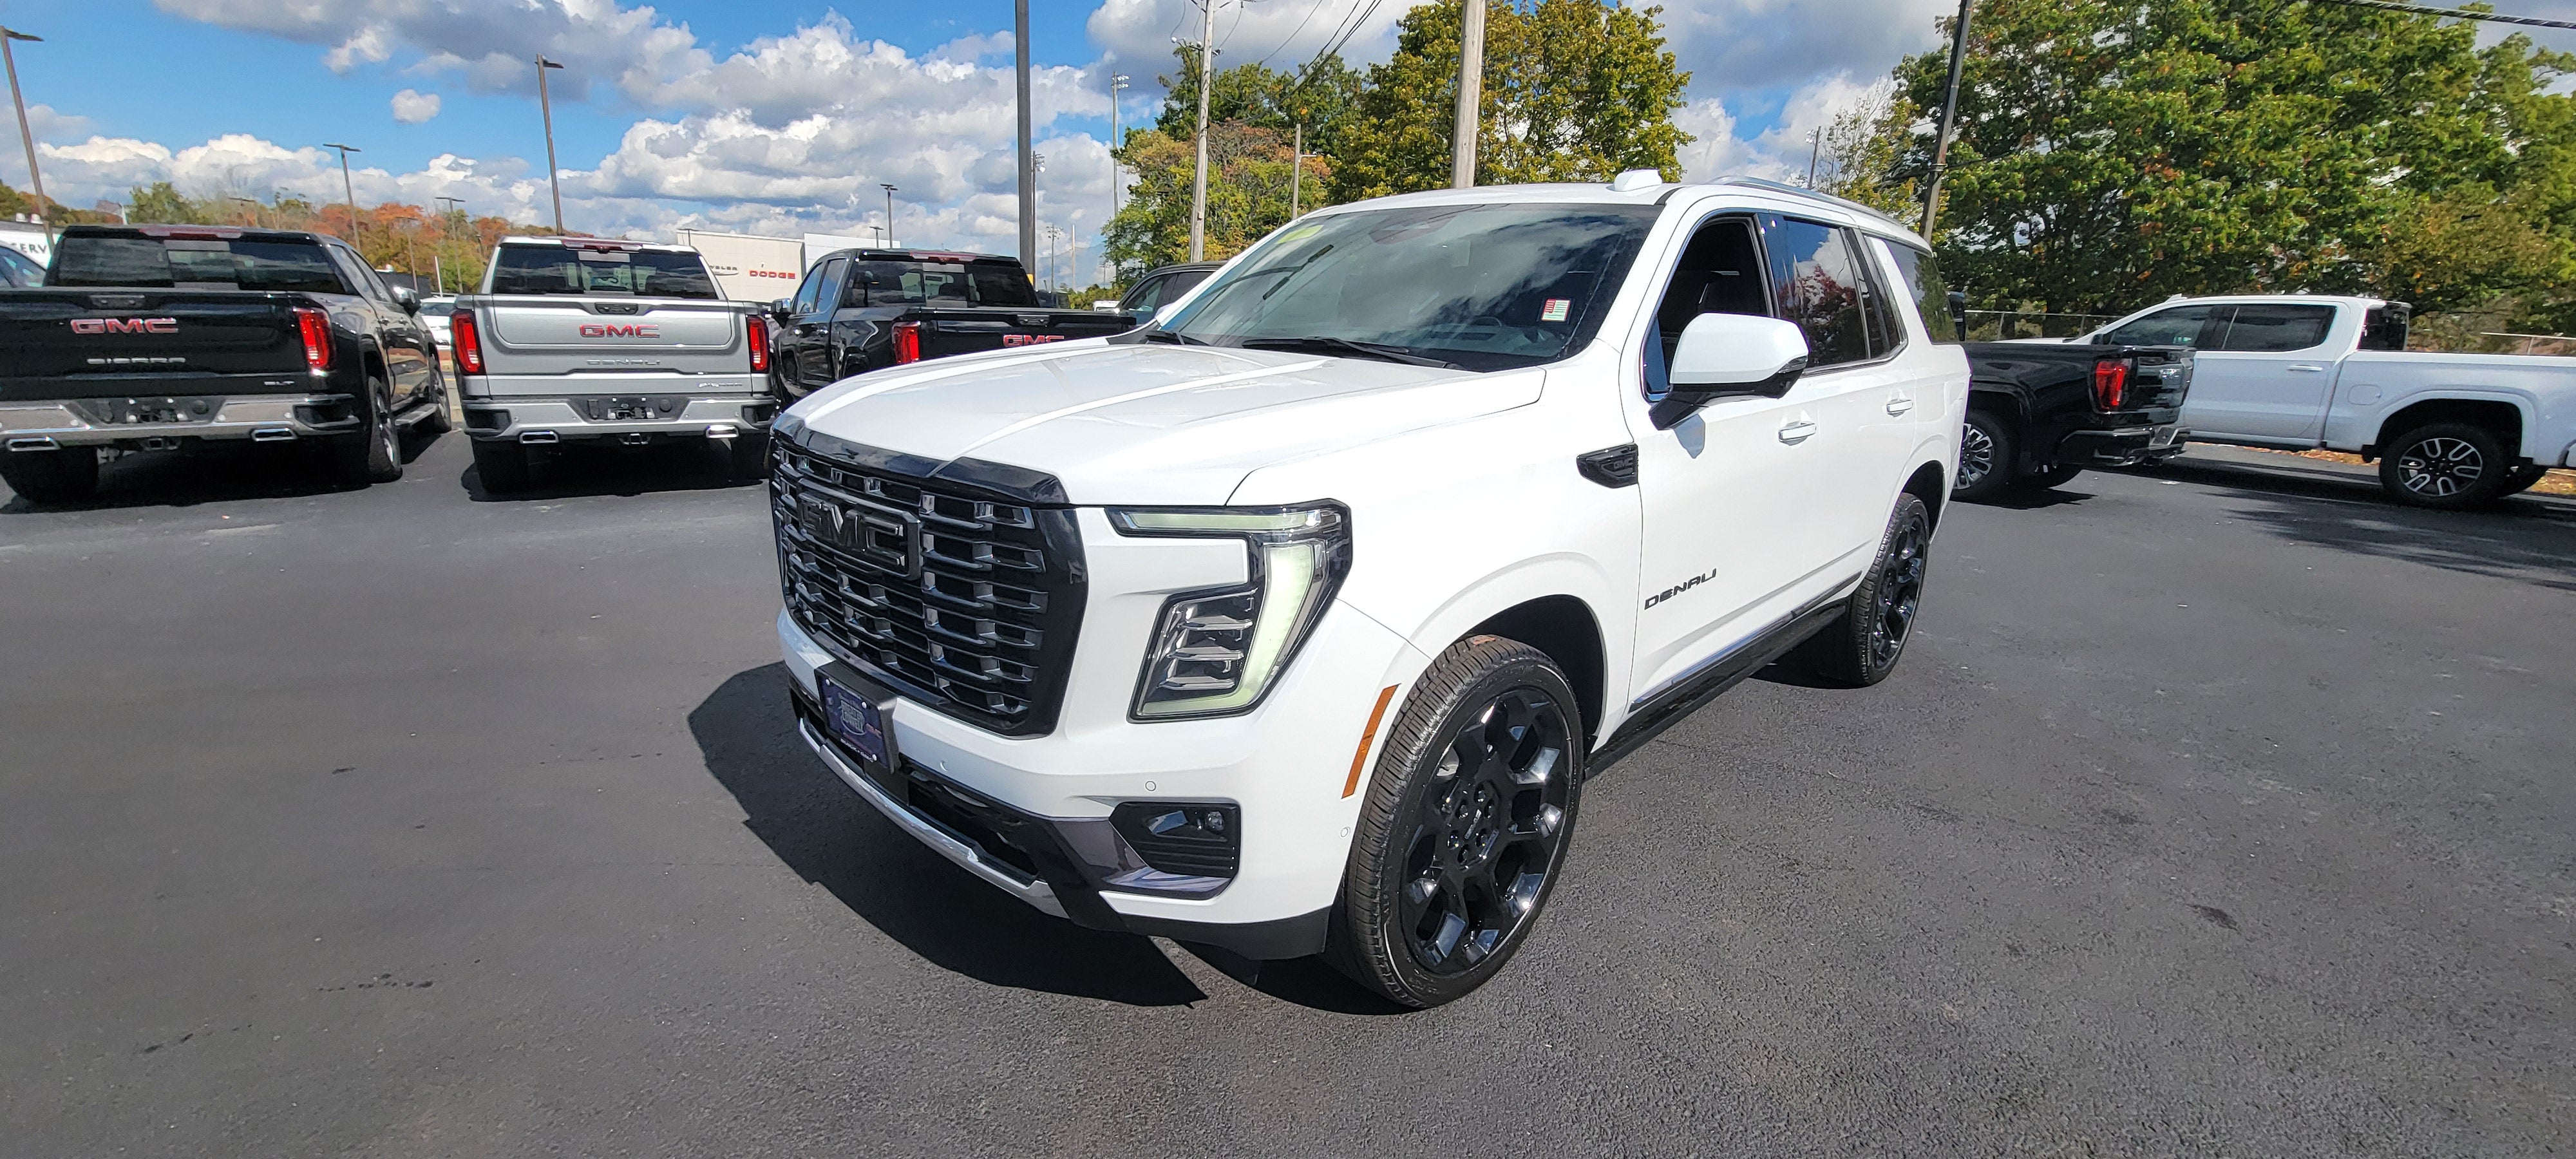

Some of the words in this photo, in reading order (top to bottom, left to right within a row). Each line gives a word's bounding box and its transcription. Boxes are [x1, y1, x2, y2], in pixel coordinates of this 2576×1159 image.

[10, 243, 46, 254] ERV
[750, 270, 795, 279] DODGE
[70, 318, 179, 334] GMC
[580, 324, 660, 338] GMC
[799, 492, 905, 567] GMC
[1644, 568, 1717, 610] DENALI
